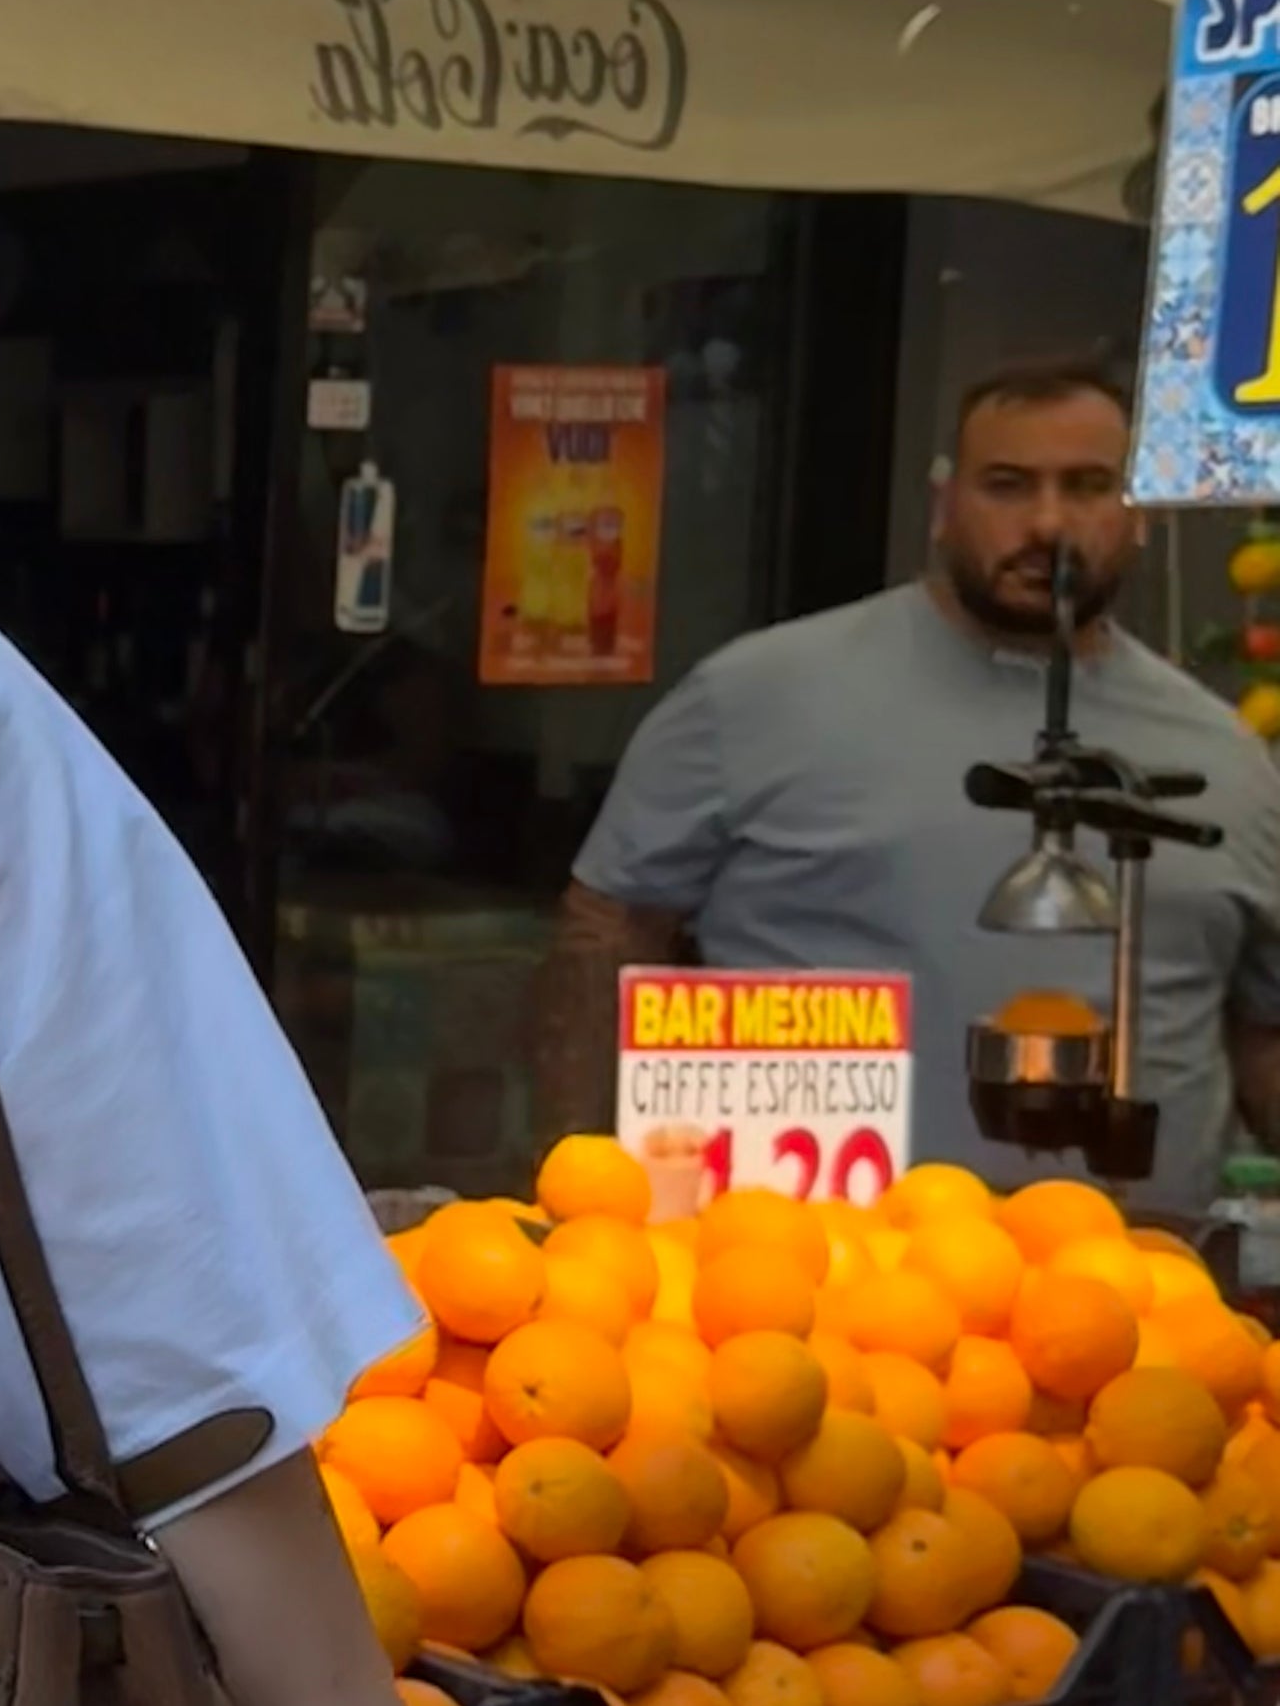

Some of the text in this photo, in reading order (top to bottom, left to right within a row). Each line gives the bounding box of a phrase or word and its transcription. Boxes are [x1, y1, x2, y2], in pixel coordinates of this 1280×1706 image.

[632, 981, 900, 1048] BAR MESSINA
[630, 1058, 899, 1116] CAFFE ESPRESSO
